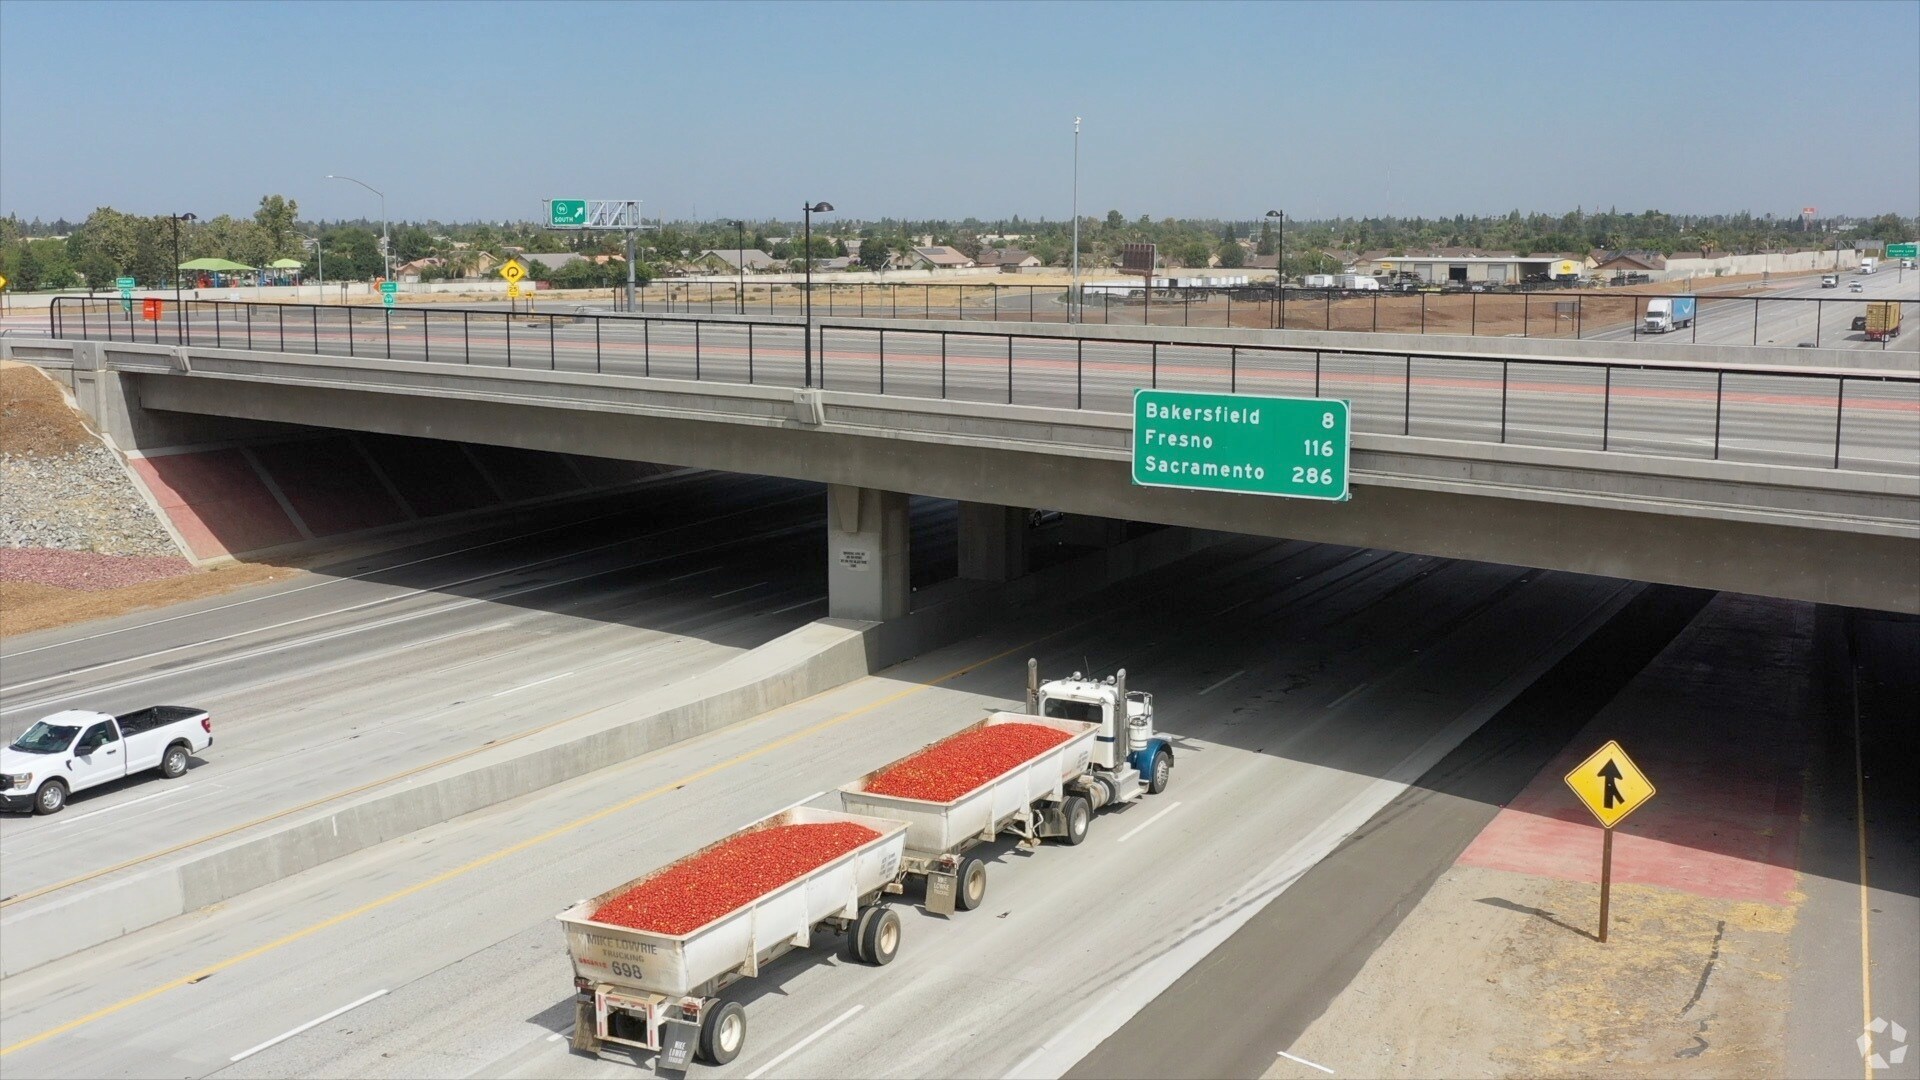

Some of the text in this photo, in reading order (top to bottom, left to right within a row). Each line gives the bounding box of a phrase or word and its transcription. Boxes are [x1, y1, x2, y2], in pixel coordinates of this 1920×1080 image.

[1146, 402, 1335, 429] Bakersfield 8
[1145, 429, 1334, 457] Fresno 116
[1145, 456, 1333, 485] Sacramento 286
[587, 933, 658, 956] MIKE LOWRIE
[602, 949, 645, 963] TRUCKING
[612, 960, 642, 980] 698
